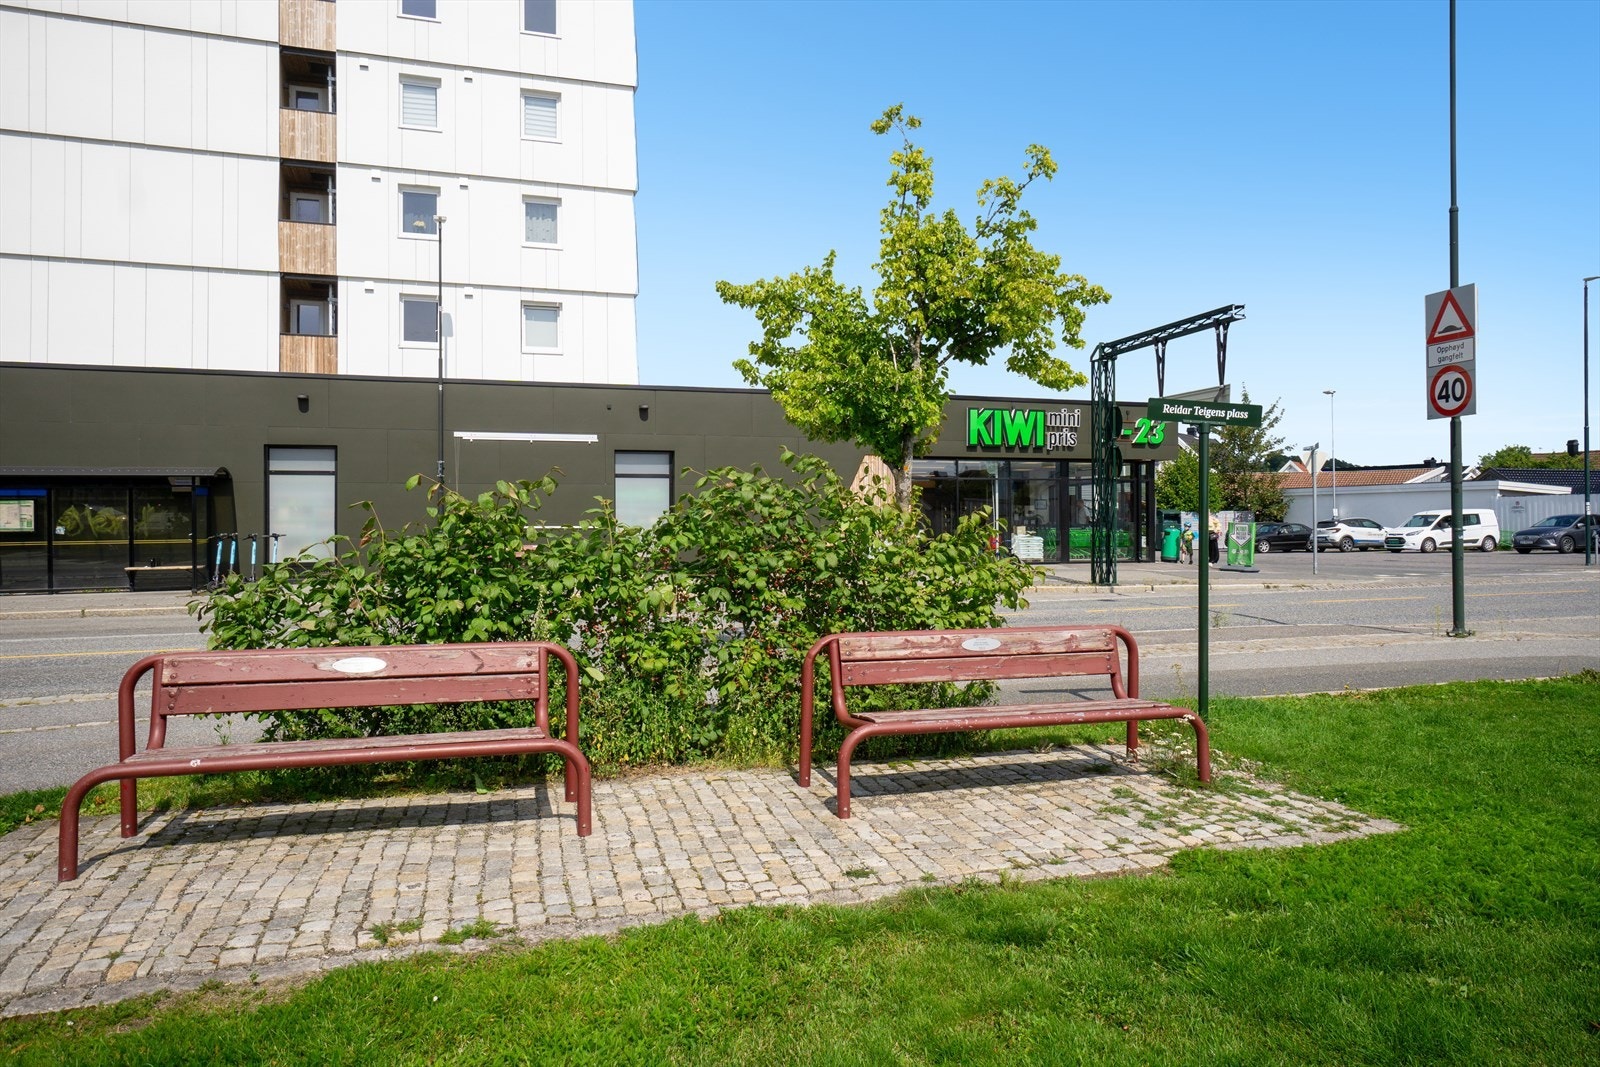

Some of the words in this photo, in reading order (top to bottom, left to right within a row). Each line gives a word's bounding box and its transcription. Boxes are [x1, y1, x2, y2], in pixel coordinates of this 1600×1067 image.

[1436, 342, 1464, 354] Opphøyd
[1437, 352, 1464, 364] gangfelt
[1437, 377, 1465, 403] 40
[1048, 408, 1081, 427] mini
[1162, 404, 1192, 415] Reidar
[1194, 406, 1225, 418] Teigens
[1226, 409, 1249, 420] plass
[967, 407, 1045, 447] KIWI
[1047, 428, 1077, 450] pris
